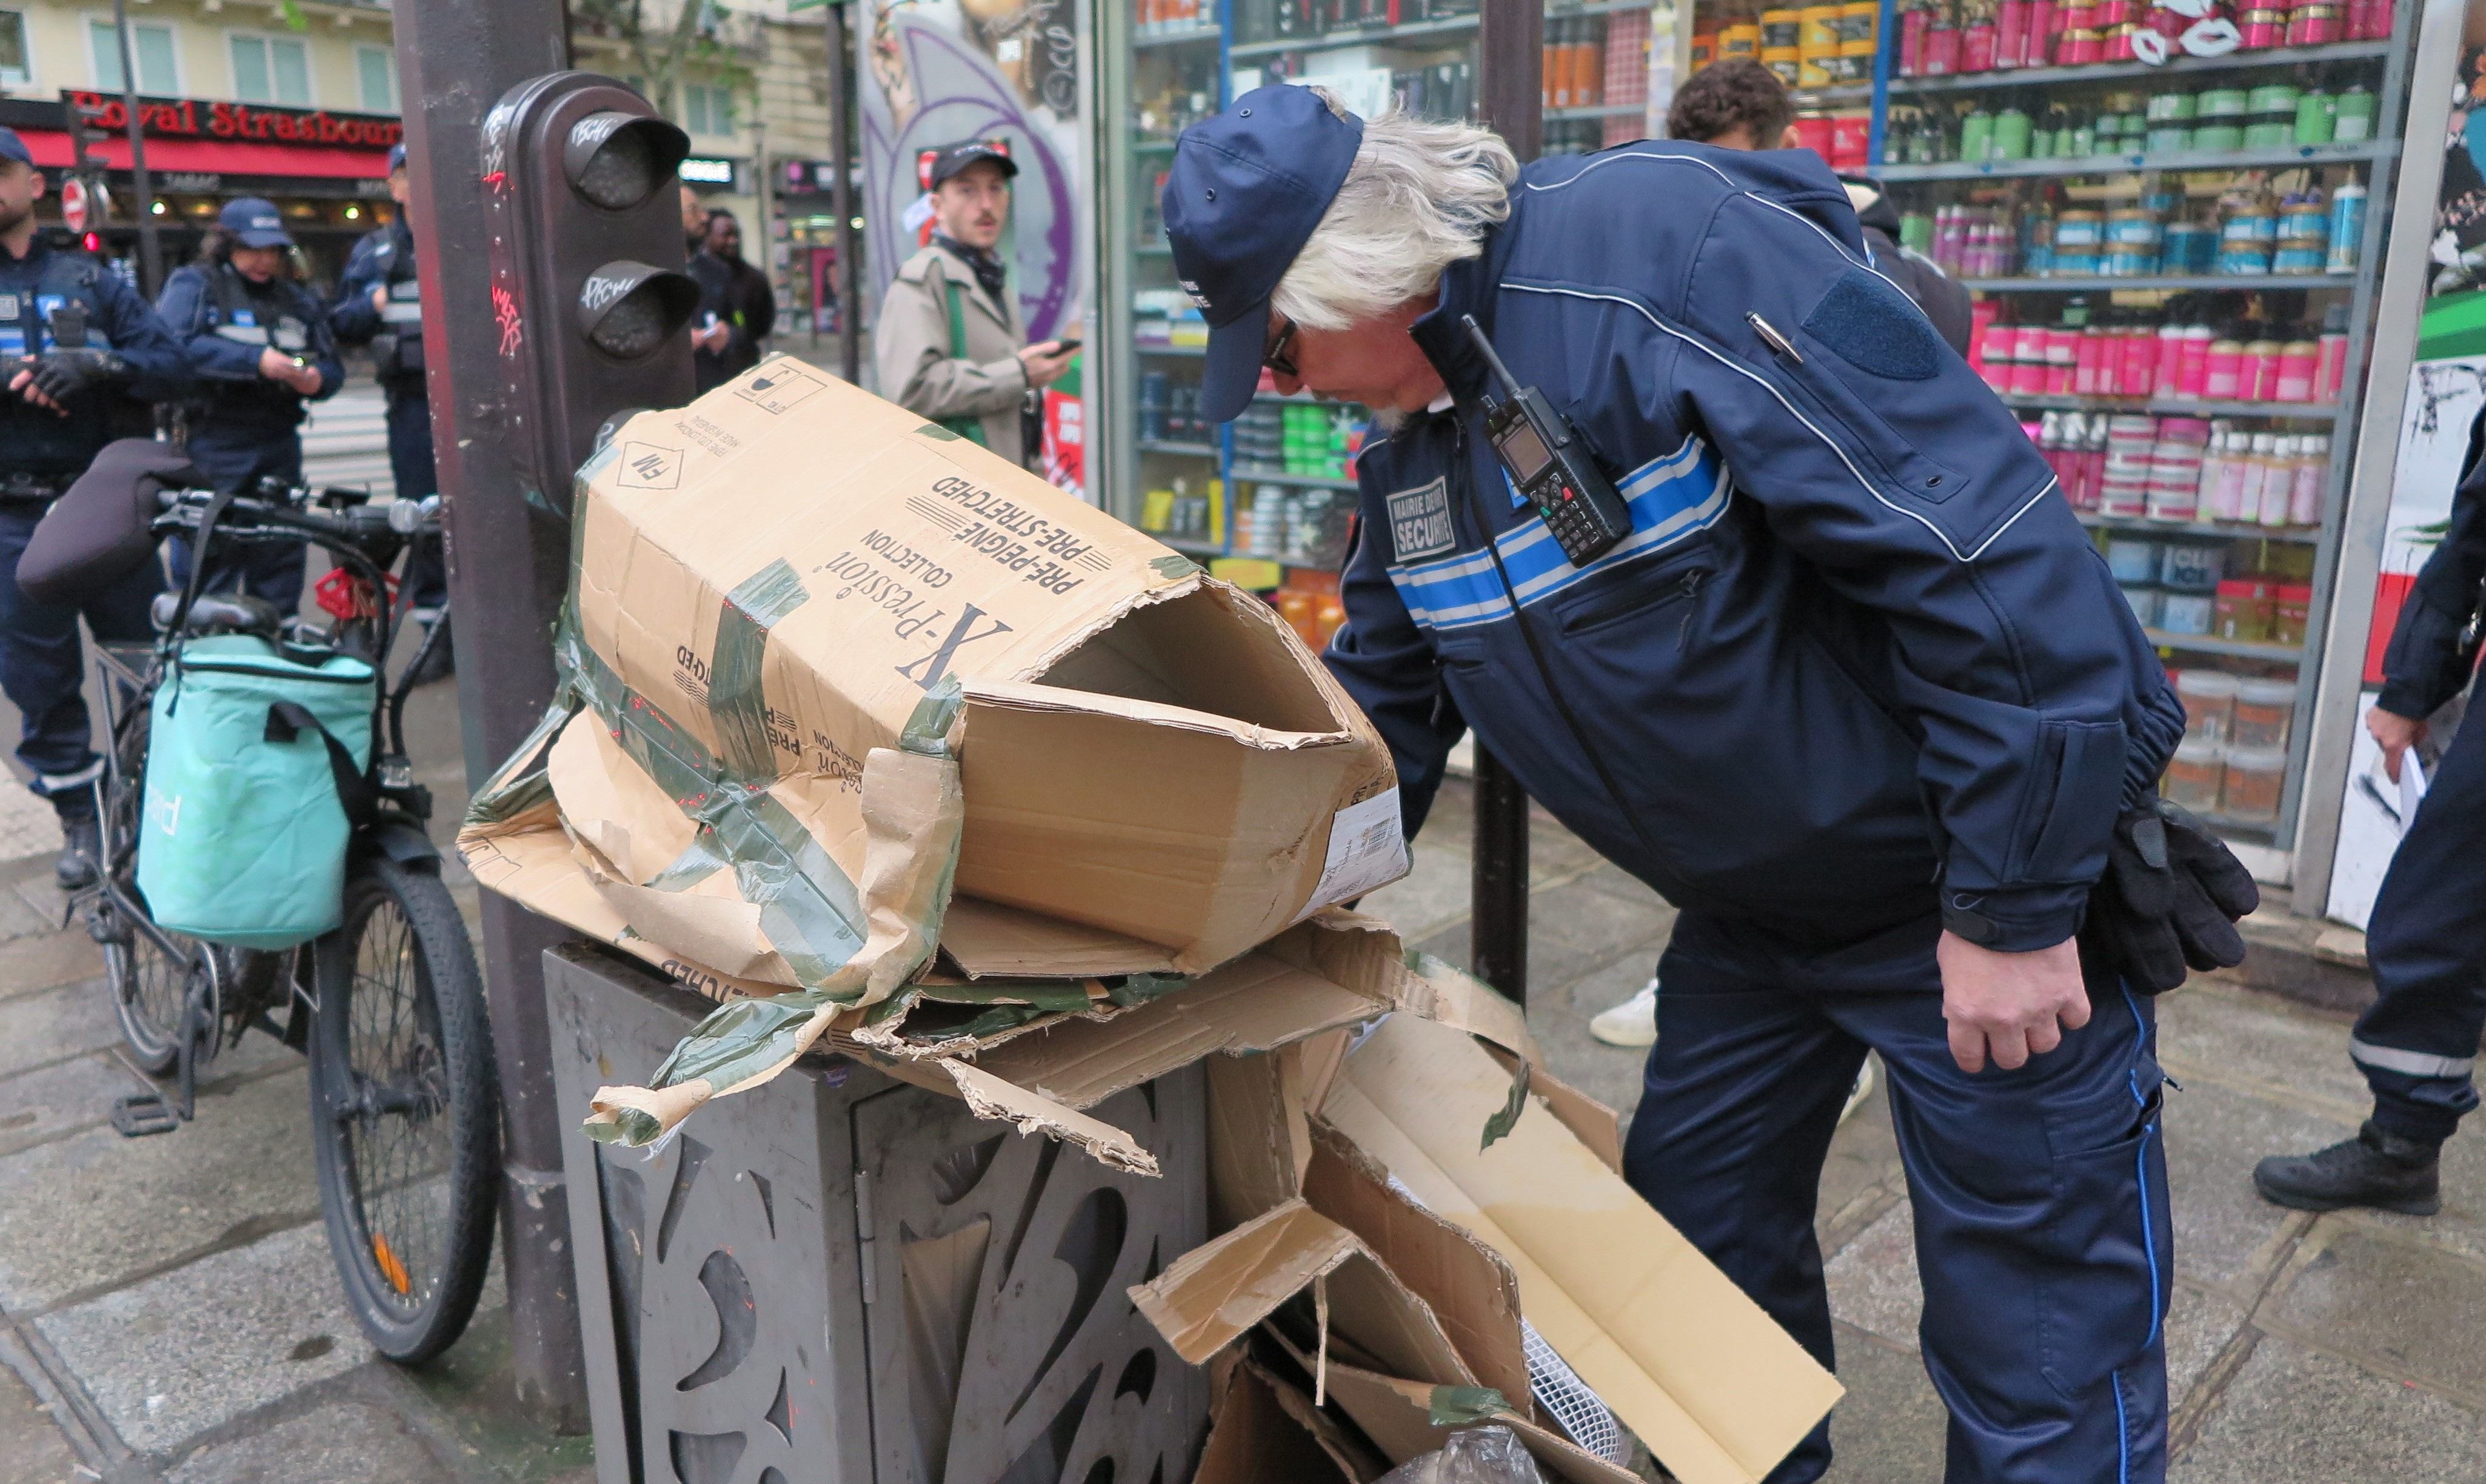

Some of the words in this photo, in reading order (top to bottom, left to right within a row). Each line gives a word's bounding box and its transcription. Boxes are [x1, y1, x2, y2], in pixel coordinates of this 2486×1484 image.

[631, 453, 671, 481] FM
[932, 476, 1093, 561] PRE-STRETCHED
[1394, 495, 1424, 520] MAIRIE
[860, 529, 953, 589] COLLECTION
[950, 522, 1085, 595] PRÉ-PEIGNÉ
